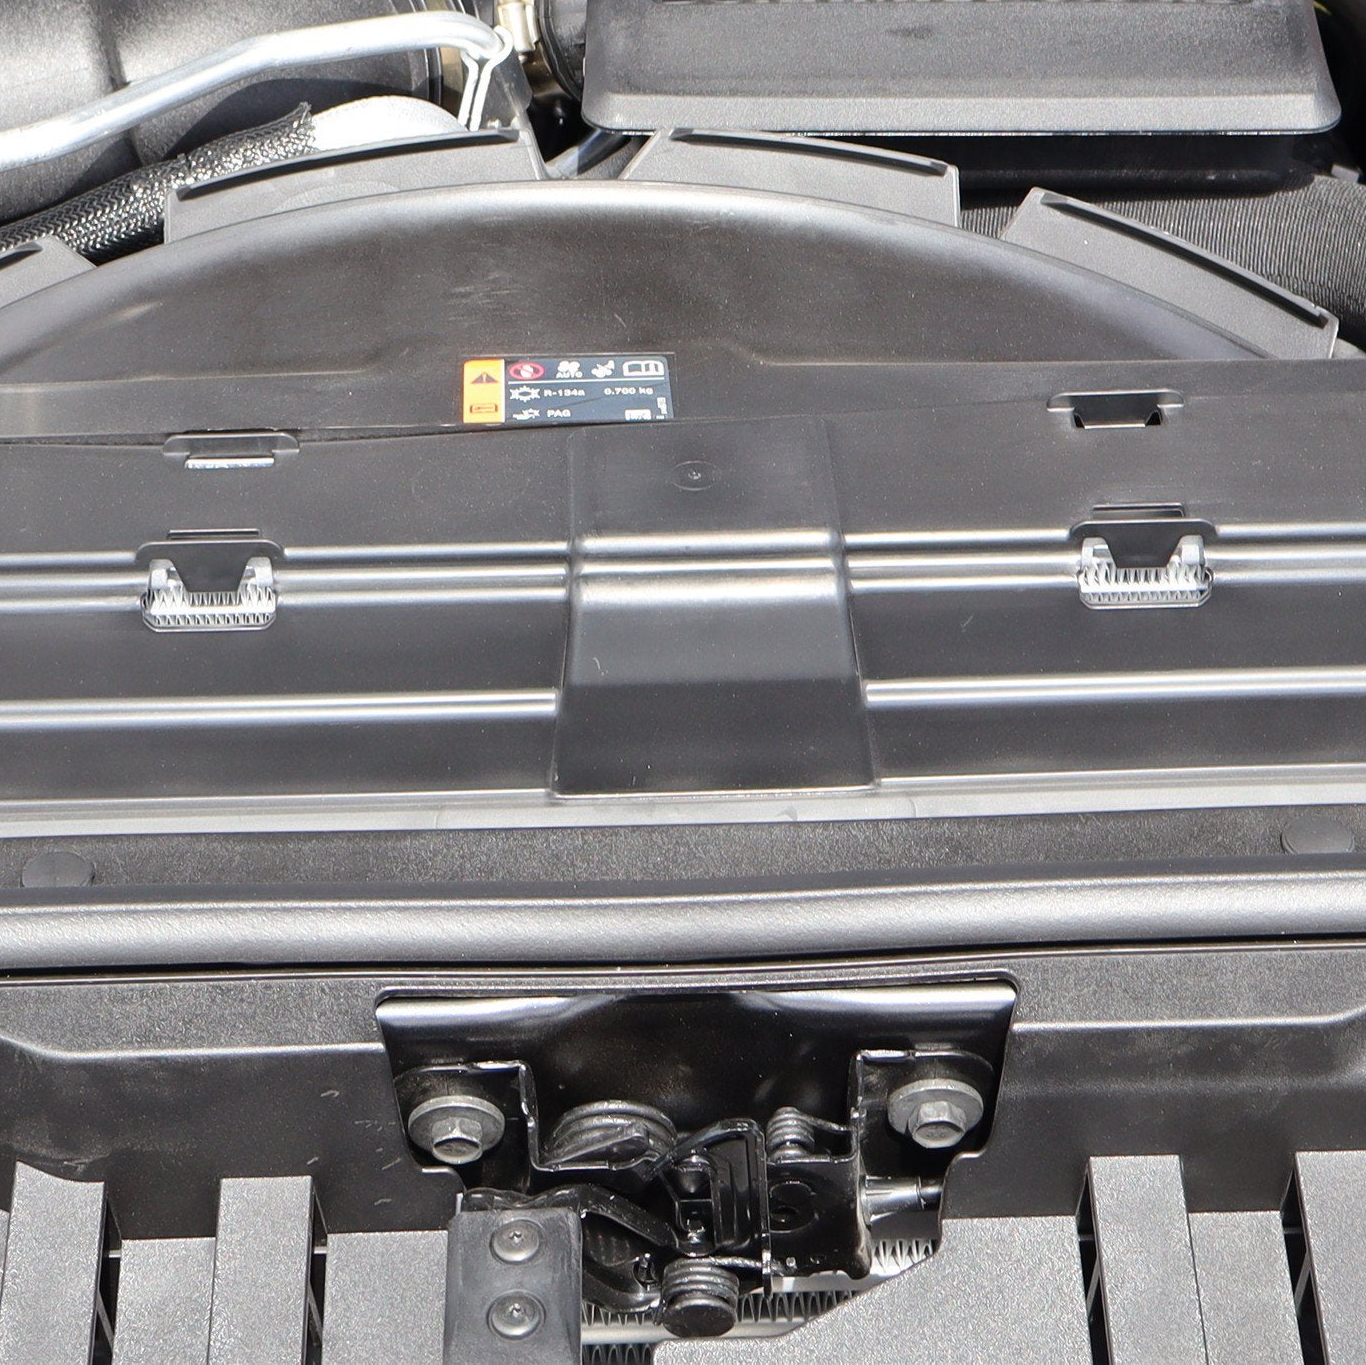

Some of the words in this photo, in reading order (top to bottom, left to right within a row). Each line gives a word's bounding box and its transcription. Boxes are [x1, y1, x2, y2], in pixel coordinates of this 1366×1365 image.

[556, 371, 583, 379] AUTO
[543, 388, 586, 397] R-134a
[603, 387, 636, 395] 0.700
[546, 409, 571, 418] PAG
